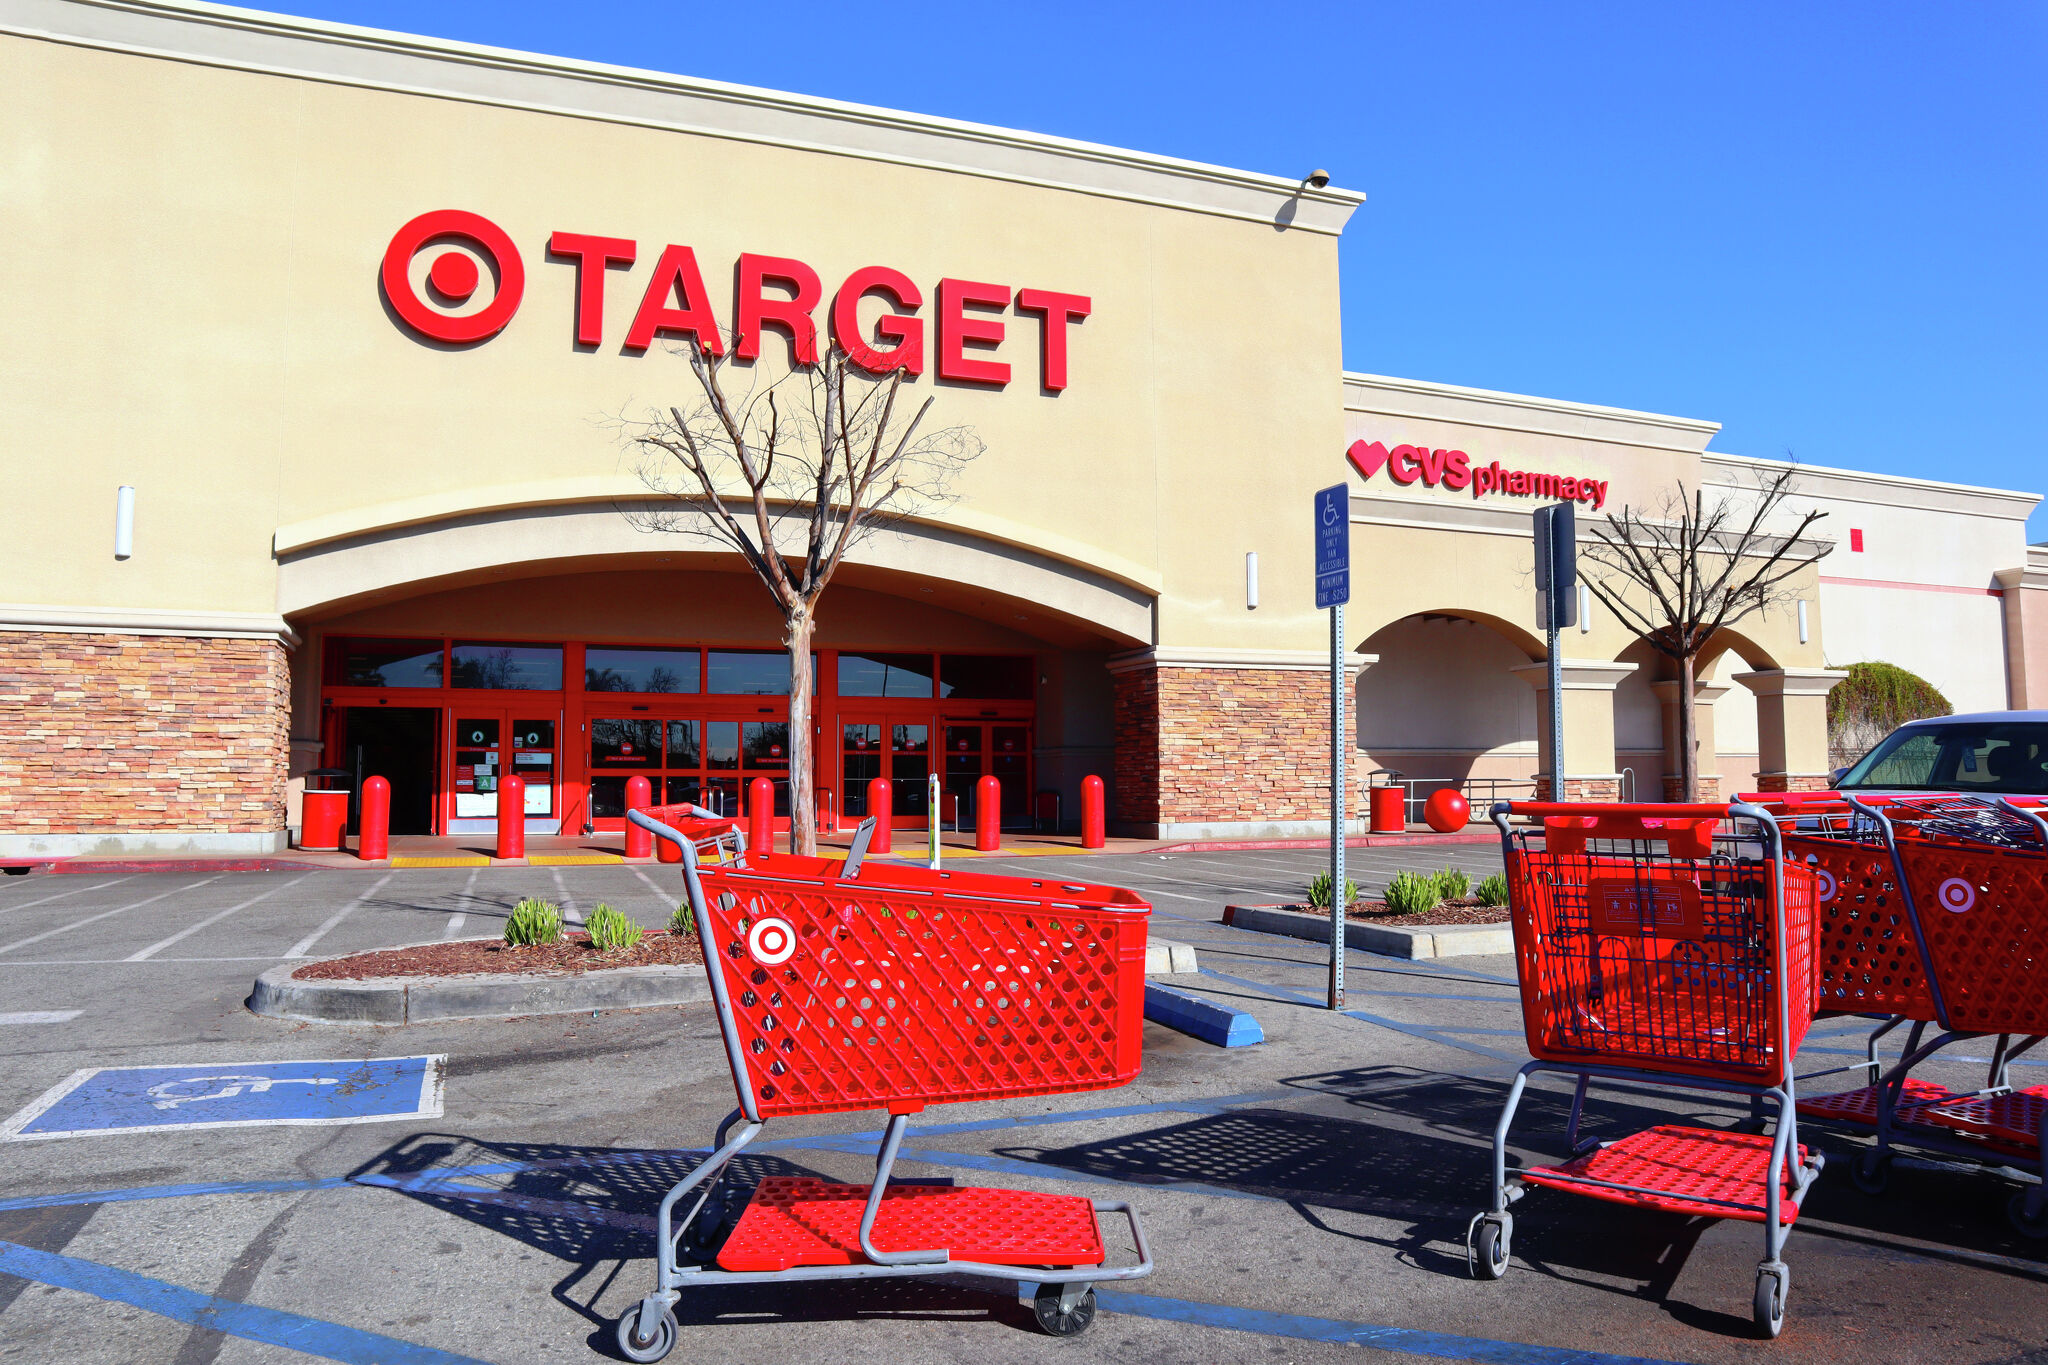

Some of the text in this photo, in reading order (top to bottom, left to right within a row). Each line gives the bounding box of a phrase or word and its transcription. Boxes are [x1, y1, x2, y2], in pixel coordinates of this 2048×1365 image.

[549, 230, 1092, 392] TARGET
[1389, 444, 1608, 510] CVS pharmacy
[1322, 526, 1342, 537] PARKING
[1326, 538, 1338, 548] ONLY
[1327, 549, 1337, 558] VAN
[1319, 557, 1345, 572] ACCESSIBLE
[1321, 575, 1343, 589] MINIMUM
[1318, 591, 1328, 603] FINE
[481, 779, 489, 787] A
